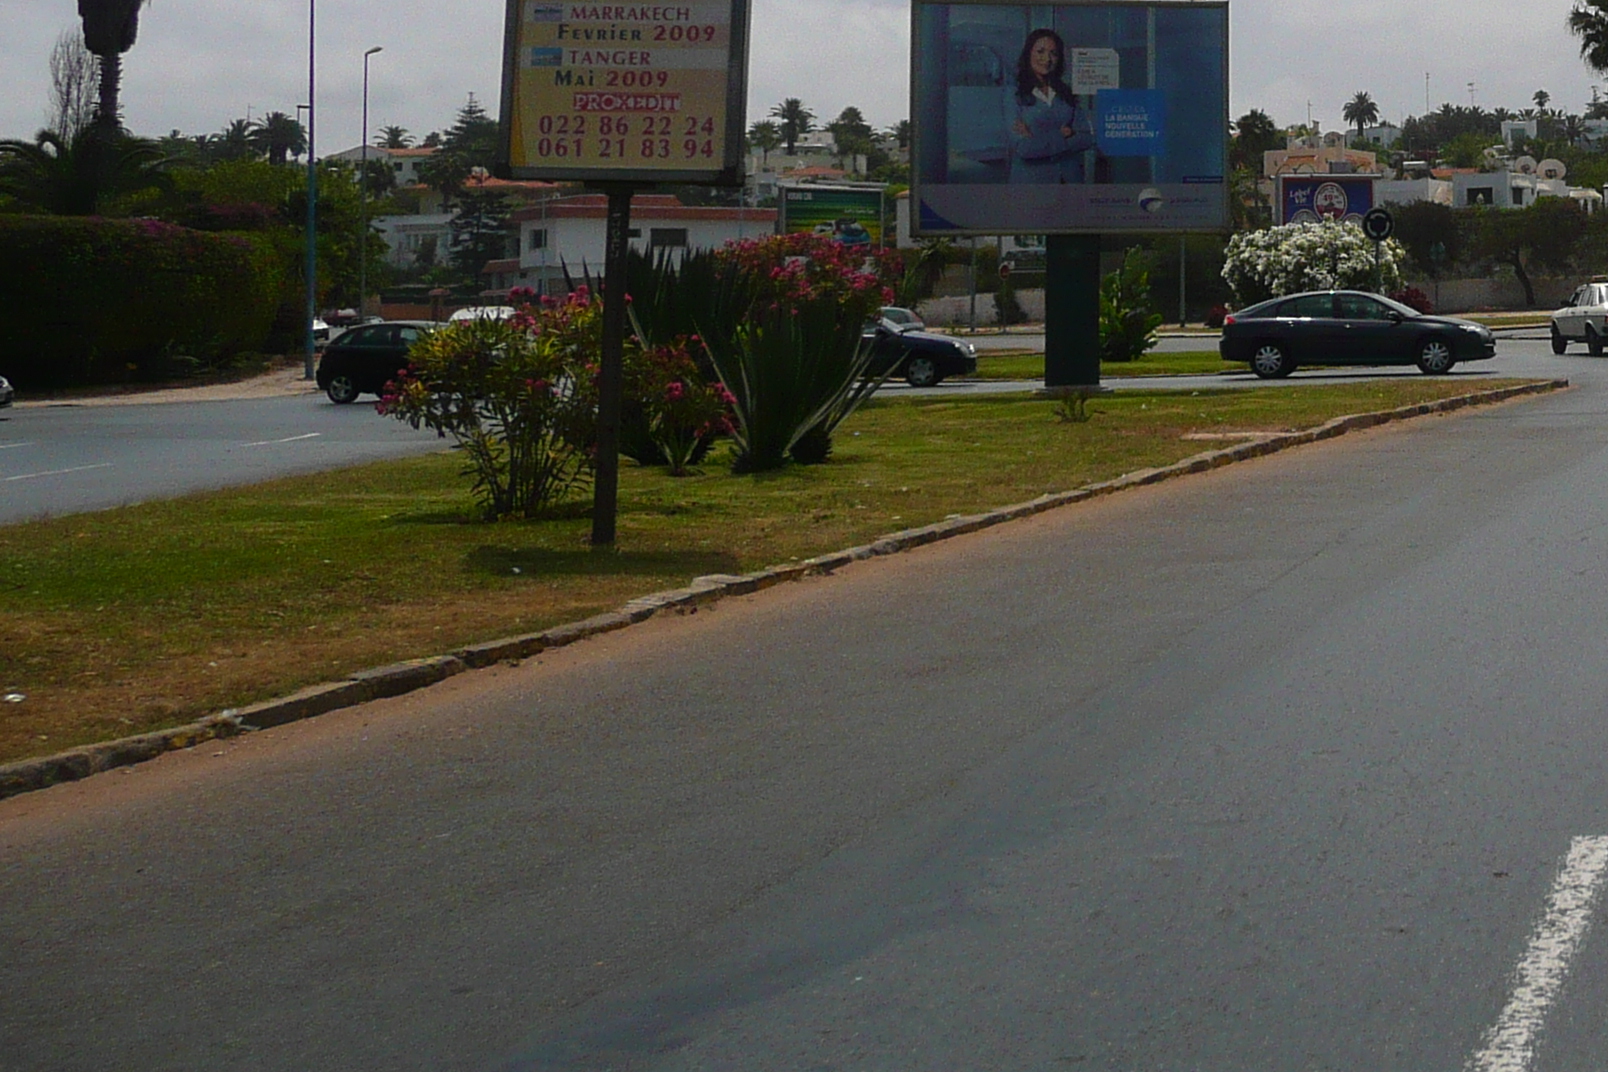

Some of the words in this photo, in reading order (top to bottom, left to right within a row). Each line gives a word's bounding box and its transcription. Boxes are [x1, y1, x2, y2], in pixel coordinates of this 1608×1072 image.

[571, 6, 690, 21] MARRAKECH
[653, 24, 716, 41] 2009
[569, 50, 651, 65] TANGER
[606, 70, 669, 87] 2009
[574, 93, 680, 111] PROXEDIT
[539, 116, 585, 135] 022
[600, 116, 629, 135] 86
[642, 117, 672, 135] 22
[684, 117, 715, 135] 24
[538, 138, 582, 157] 061
[599, 138, 626, 157] 21
[641, 139, 671, 157] 83
[684, 139, 715, 158] 94
